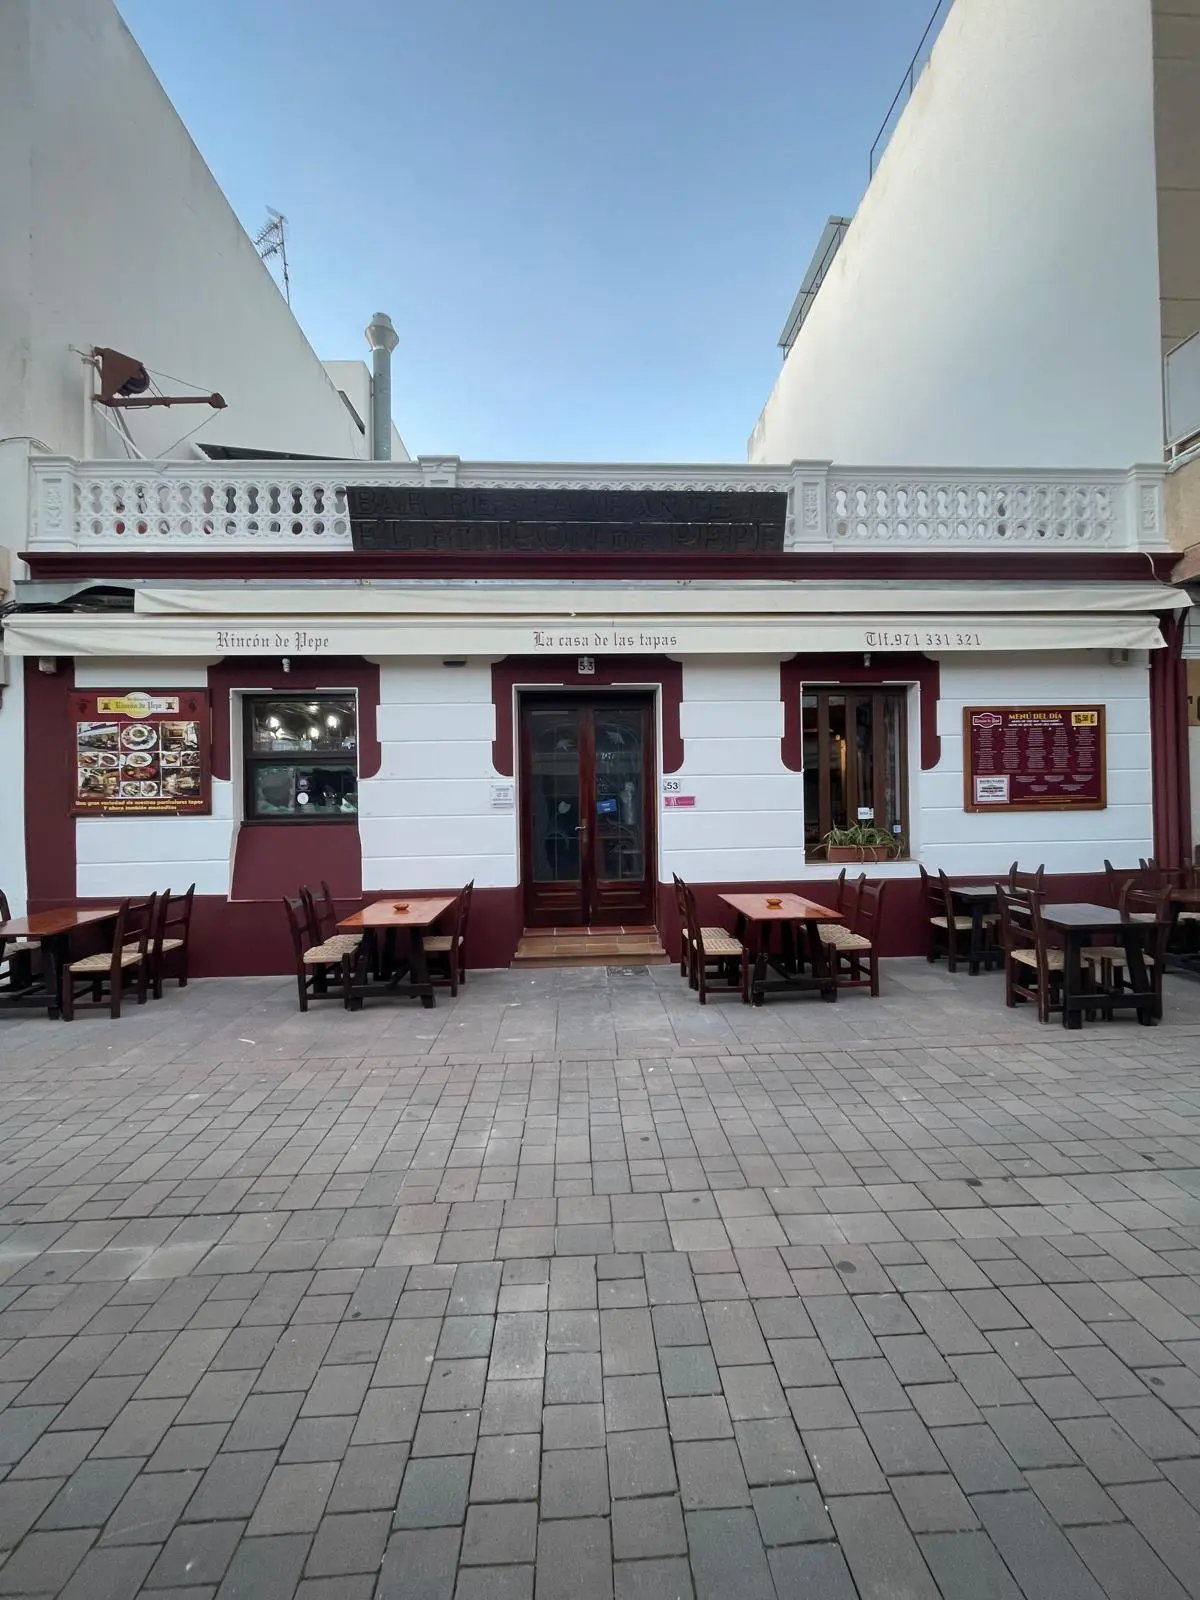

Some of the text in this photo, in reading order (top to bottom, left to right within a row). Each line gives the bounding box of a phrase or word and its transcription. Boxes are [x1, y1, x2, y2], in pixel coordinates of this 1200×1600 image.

[353, 489, 428, 518] BAR
[356, 521, 413, 550] EL
[671, 522, 782, 552] PEPE
[216, 631, 329, 651] Rincón de Pepe
[533, 631, 677, 650] La casa de las tapas
[925, 633, 950, 646] 331
[956, 633, 981, 646] 321
[579, 661, 594, 671] 53
[1008, 712, 1032, 720] MENÚ
[1049, 711, 1063, 719] DÍA
[666, 781, 679, 790] 53
